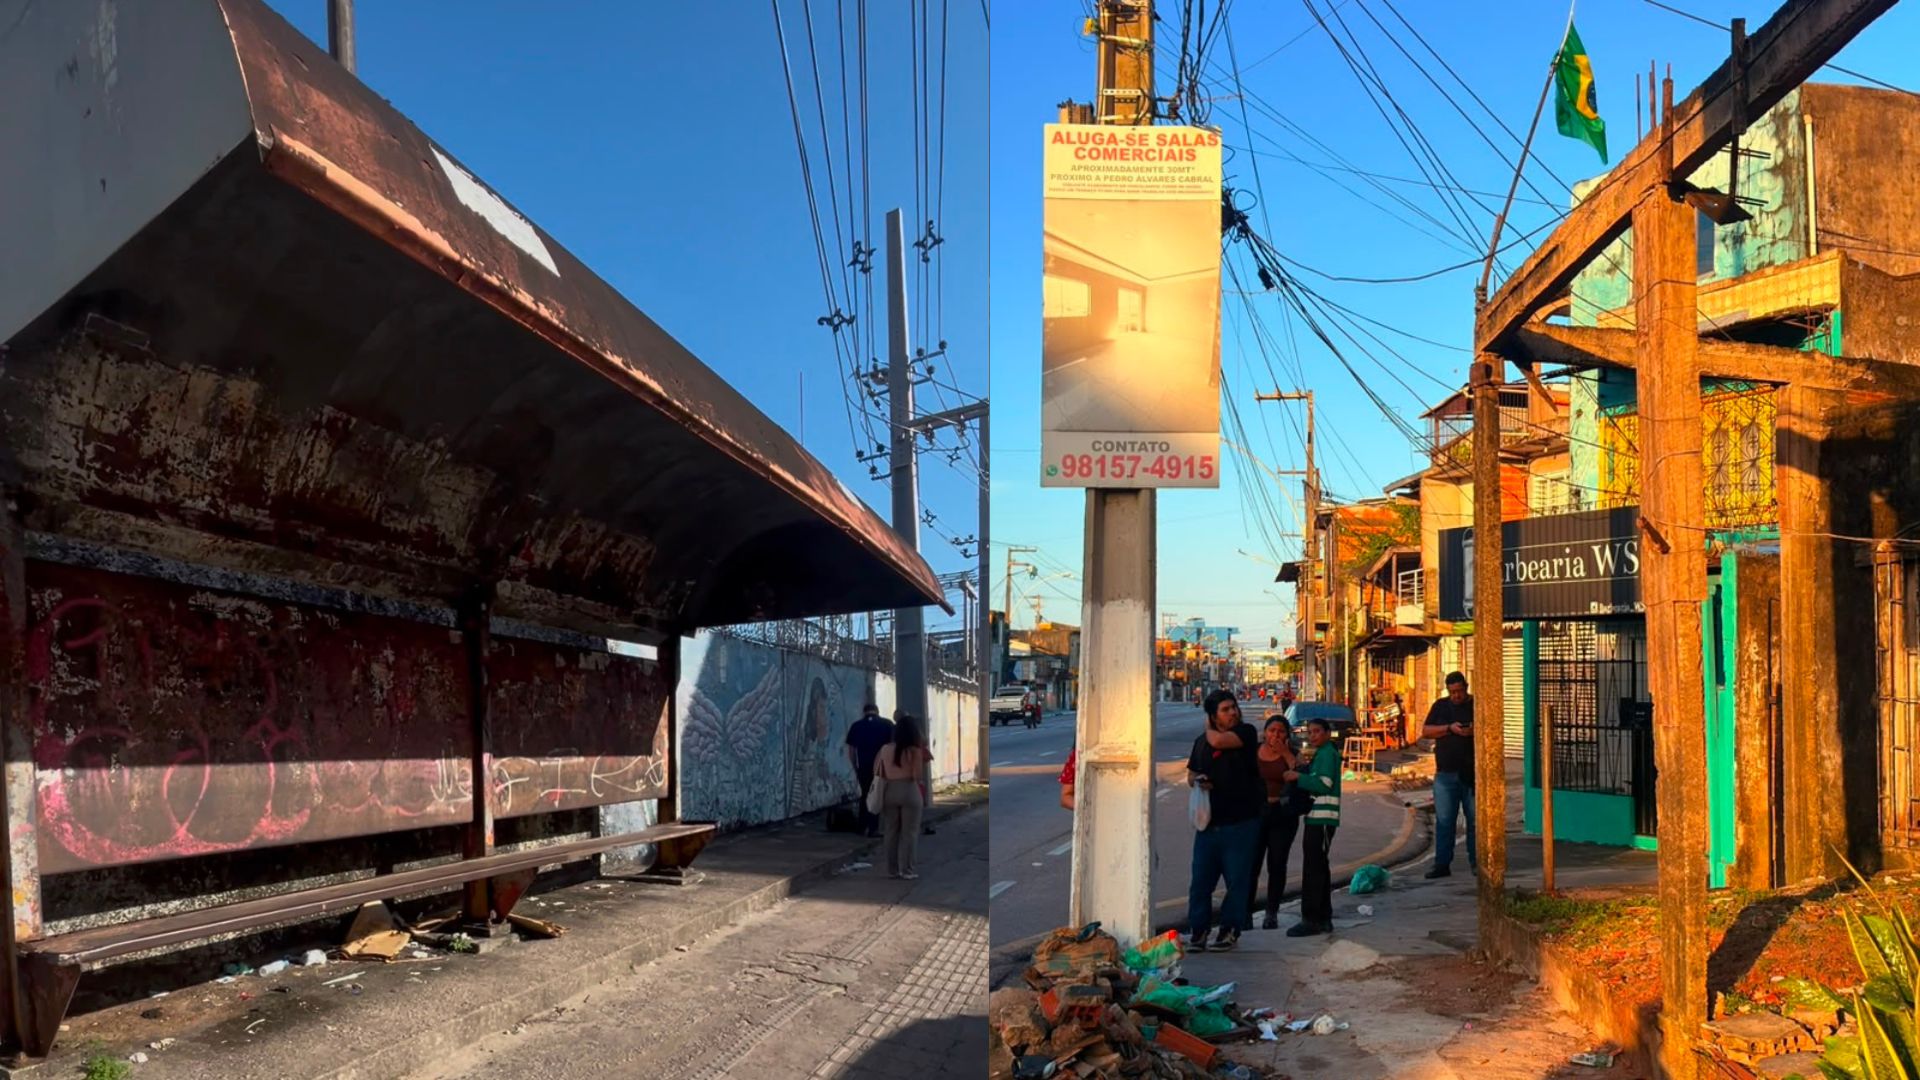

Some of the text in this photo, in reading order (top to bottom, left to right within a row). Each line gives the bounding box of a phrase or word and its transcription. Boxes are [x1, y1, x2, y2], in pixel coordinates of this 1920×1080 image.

[1052, 131, 1218, 147] ALUGA-SE SALAS
[1074, 147, 1197, 162] COMERCIAIS
[1071, 164, 1164, 174] APROXIMADAMENTE
[1096, 174, 1102, 182] A
[1104, 175, 1133, 183] PEDRO
[1178, 175, 1214, 183] CABRAL
[1091, 440, 1170, 453] CONTATO
[1061, 454, 1214, 479] 98157-4915
[1503, 541, 1639, 583] rbearia WS
